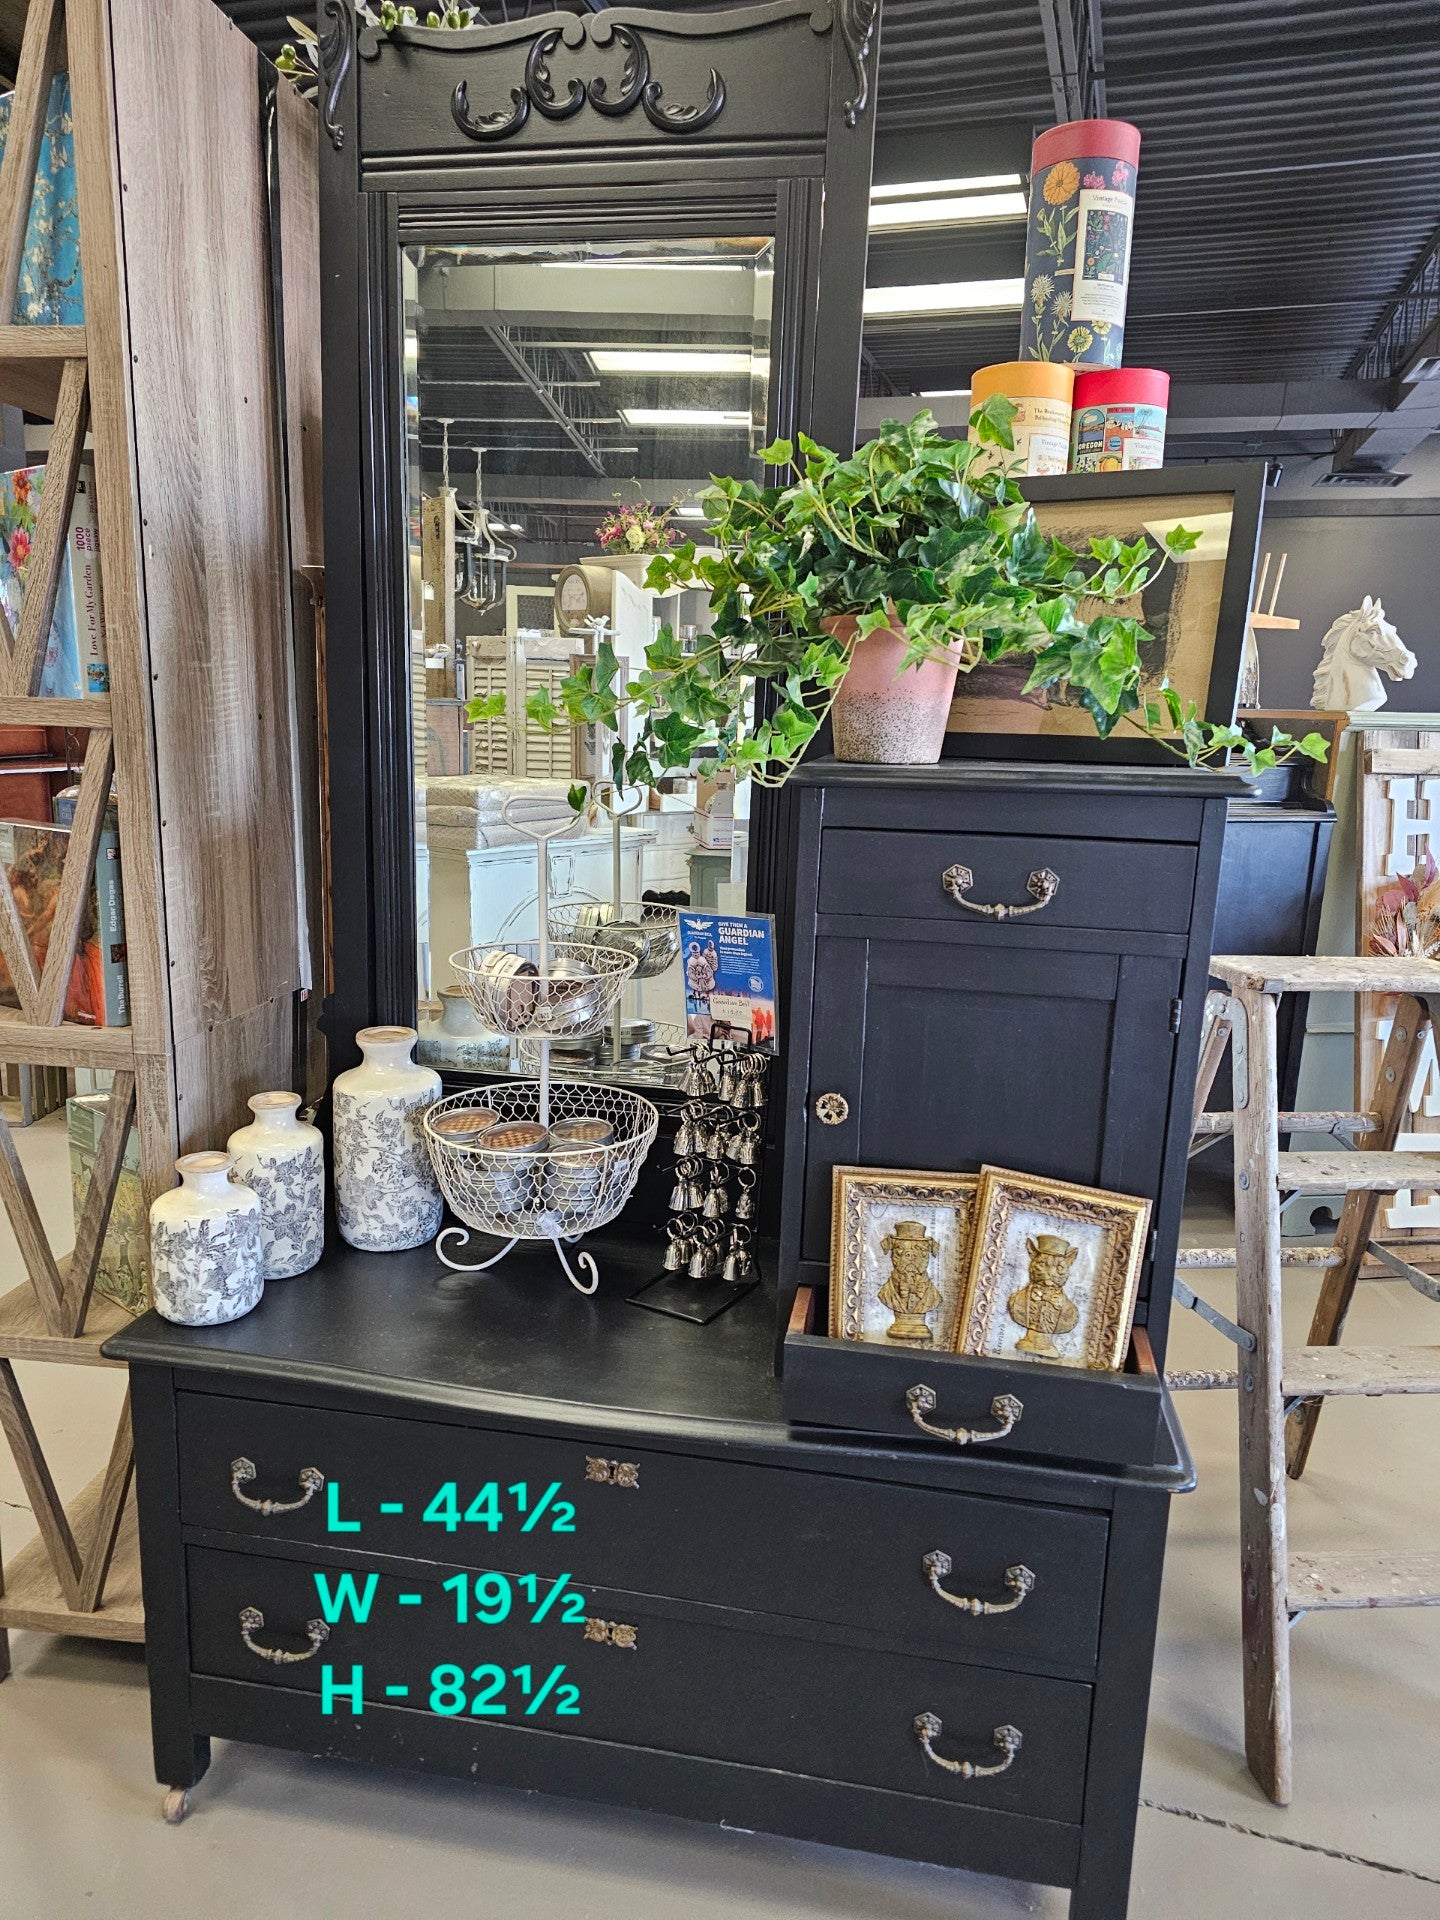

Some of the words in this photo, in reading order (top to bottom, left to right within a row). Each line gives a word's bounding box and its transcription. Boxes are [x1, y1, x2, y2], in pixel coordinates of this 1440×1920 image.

[1078, 440, 1103, 450] OREGON
[75, 526, 85, 552] 1000
[84, 527, 93, 552] piece
[83, 564, 94, 598] Garden
[86, 601, 96, 614] My
[87, 614, 97, 631] For
[90, 634, 99, 656] Love
[108, 879, 116, 907] Degas
[109, 906, 118, 932] Edgar
[718, 927, 765, 939] GUARDIAN
[719, 936, 749, 946] ANGEL
[116, 974, 125, 1000] Burrell
[118, 1000, 126, 1014] The
